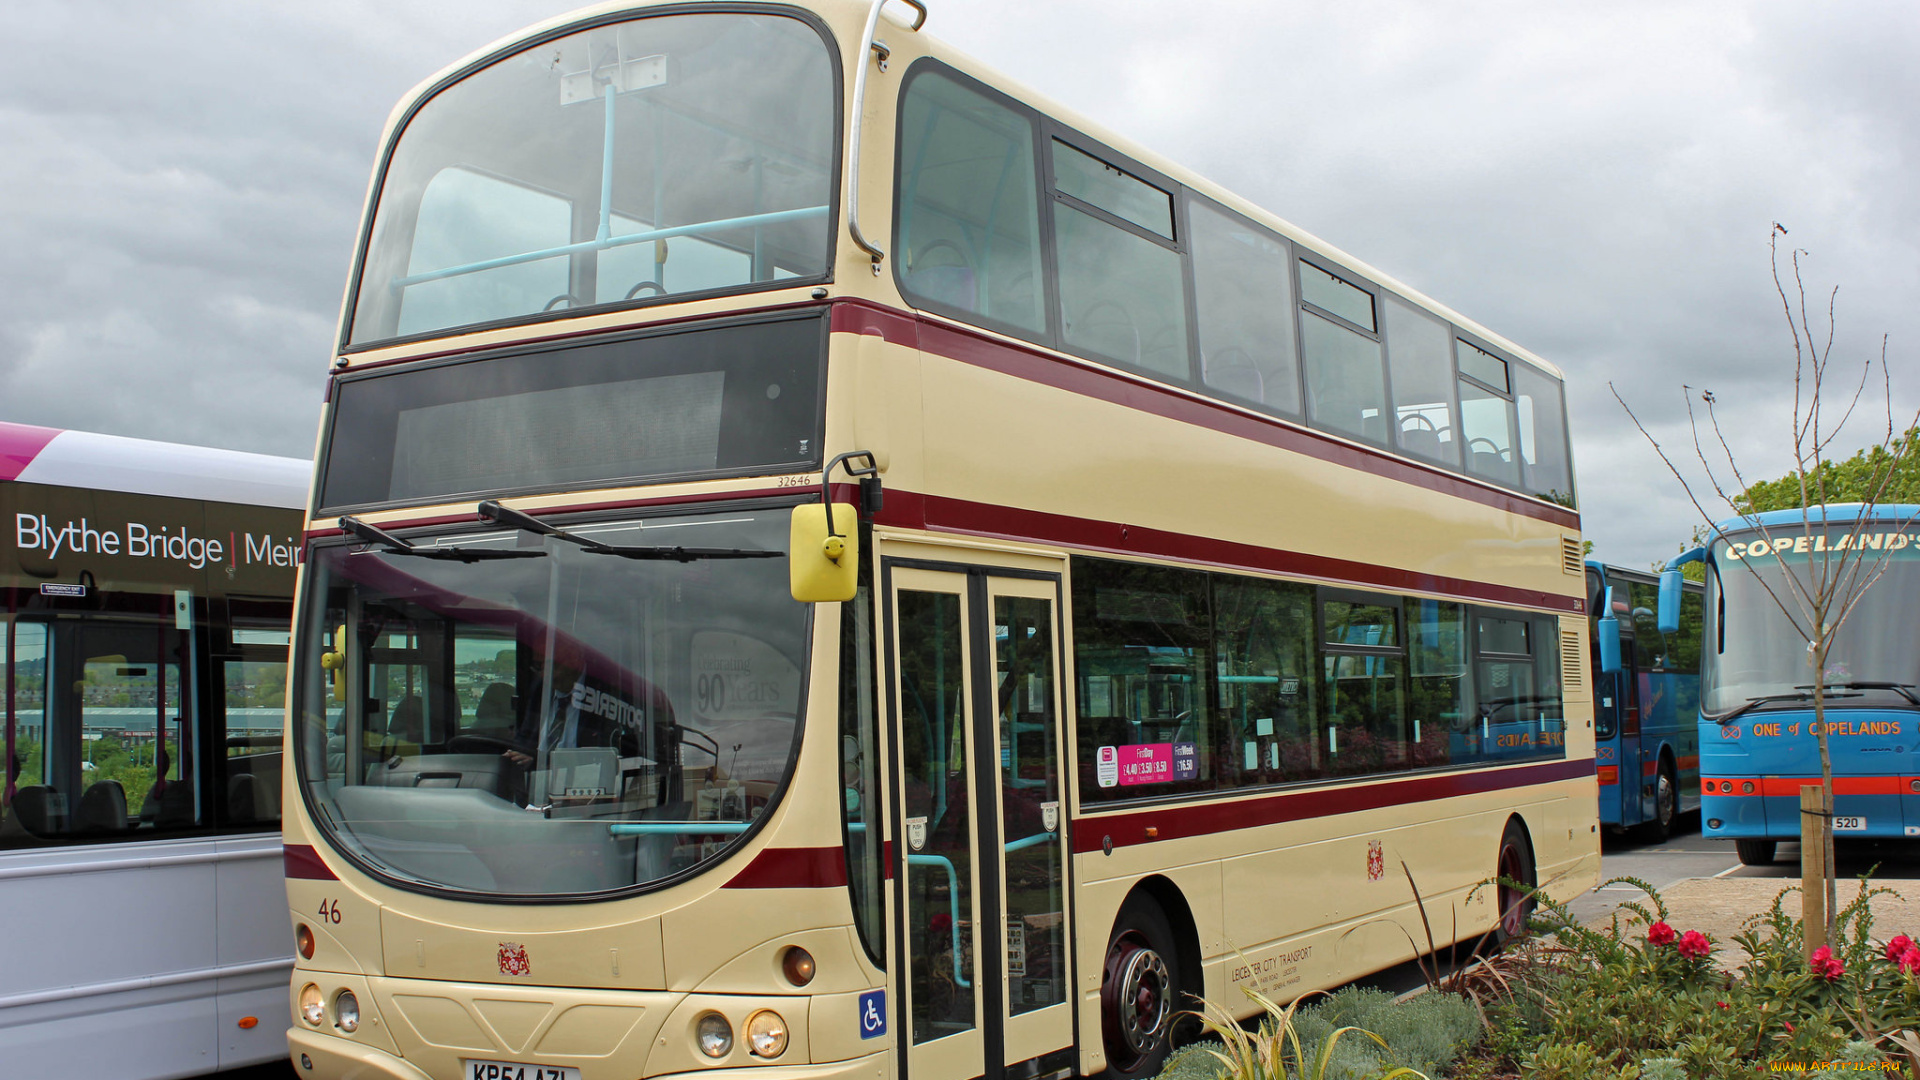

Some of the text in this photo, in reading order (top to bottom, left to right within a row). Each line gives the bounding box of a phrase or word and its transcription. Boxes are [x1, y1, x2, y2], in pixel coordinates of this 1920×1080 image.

[778, 475, 811, 487] 32646
[16, 513, 120, 559] Blythe
[127, 523, 223, 569] Bridge
[697, 673, 780, 713] 90 Years
[1753, 722, 1781, 736] ONE
[1788, 722, 1800, 736] of
[1123, 763, 1138, 776] £4.40
[1153, 760, 1167, 773] £8.50
[1177, 759, 1193, 771] £16.50
[1836, 817, 1858, 828] 520
[318, 897, 342, 924] 46
[1231, 946, 1312, 982] LEICESTER CITY TRANSPORT
